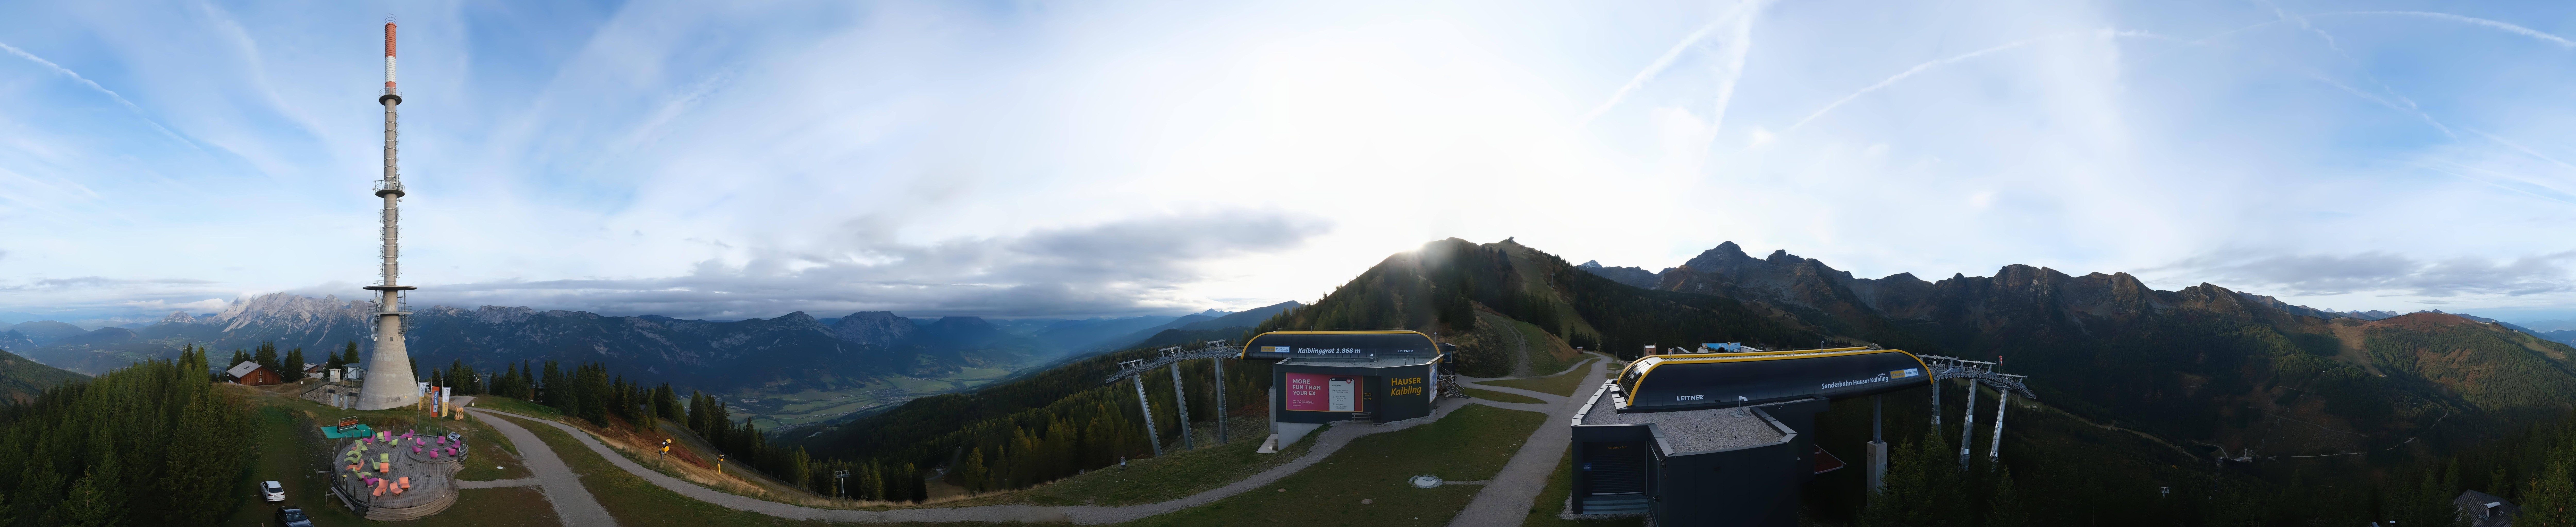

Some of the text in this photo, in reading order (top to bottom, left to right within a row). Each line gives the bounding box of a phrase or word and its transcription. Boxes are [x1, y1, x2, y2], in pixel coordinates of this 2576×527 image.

[1392, 377, 1421, 386] HAUSER
[1822, 380, 1852, 389] Senderbahn
[1391, 386, 1421, 396] Kaibling
